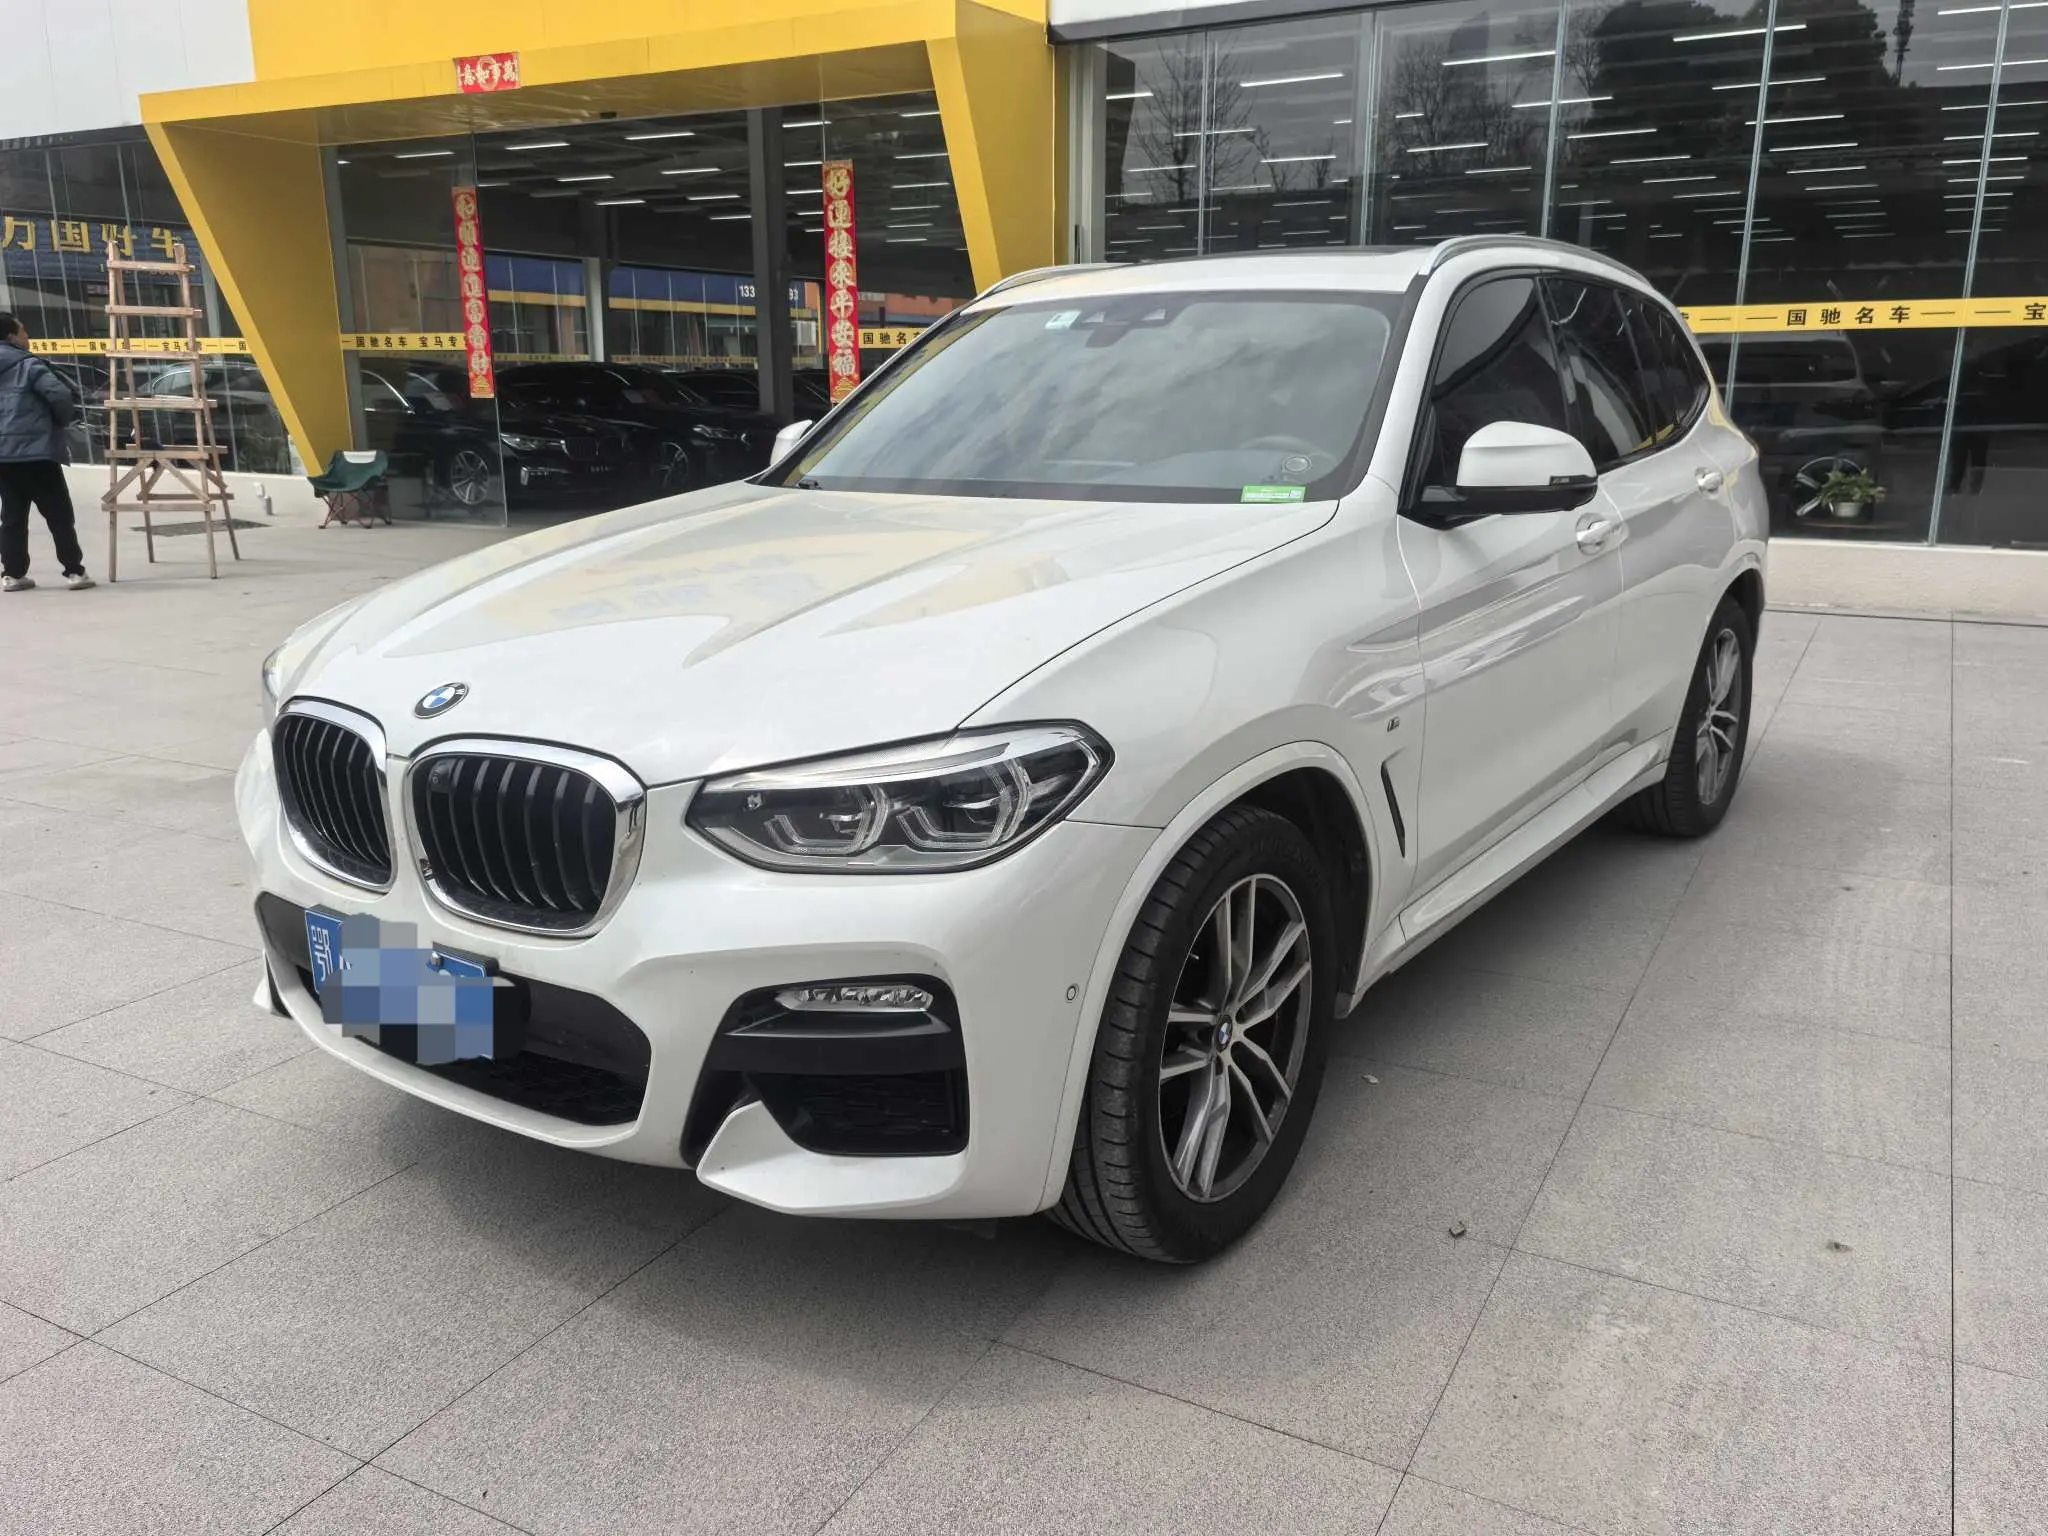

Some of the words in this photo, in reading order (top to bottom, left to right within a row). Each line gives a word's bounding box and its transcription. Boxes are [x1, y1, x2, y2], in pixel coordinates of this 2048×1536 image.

[1787, 305, 1911, 326] 国驰名车
[2023, 303, 2047, 320] 宝
[356, 335, 408, 348] 国驰名车
[419, 335, 468, 348] 宝马专
